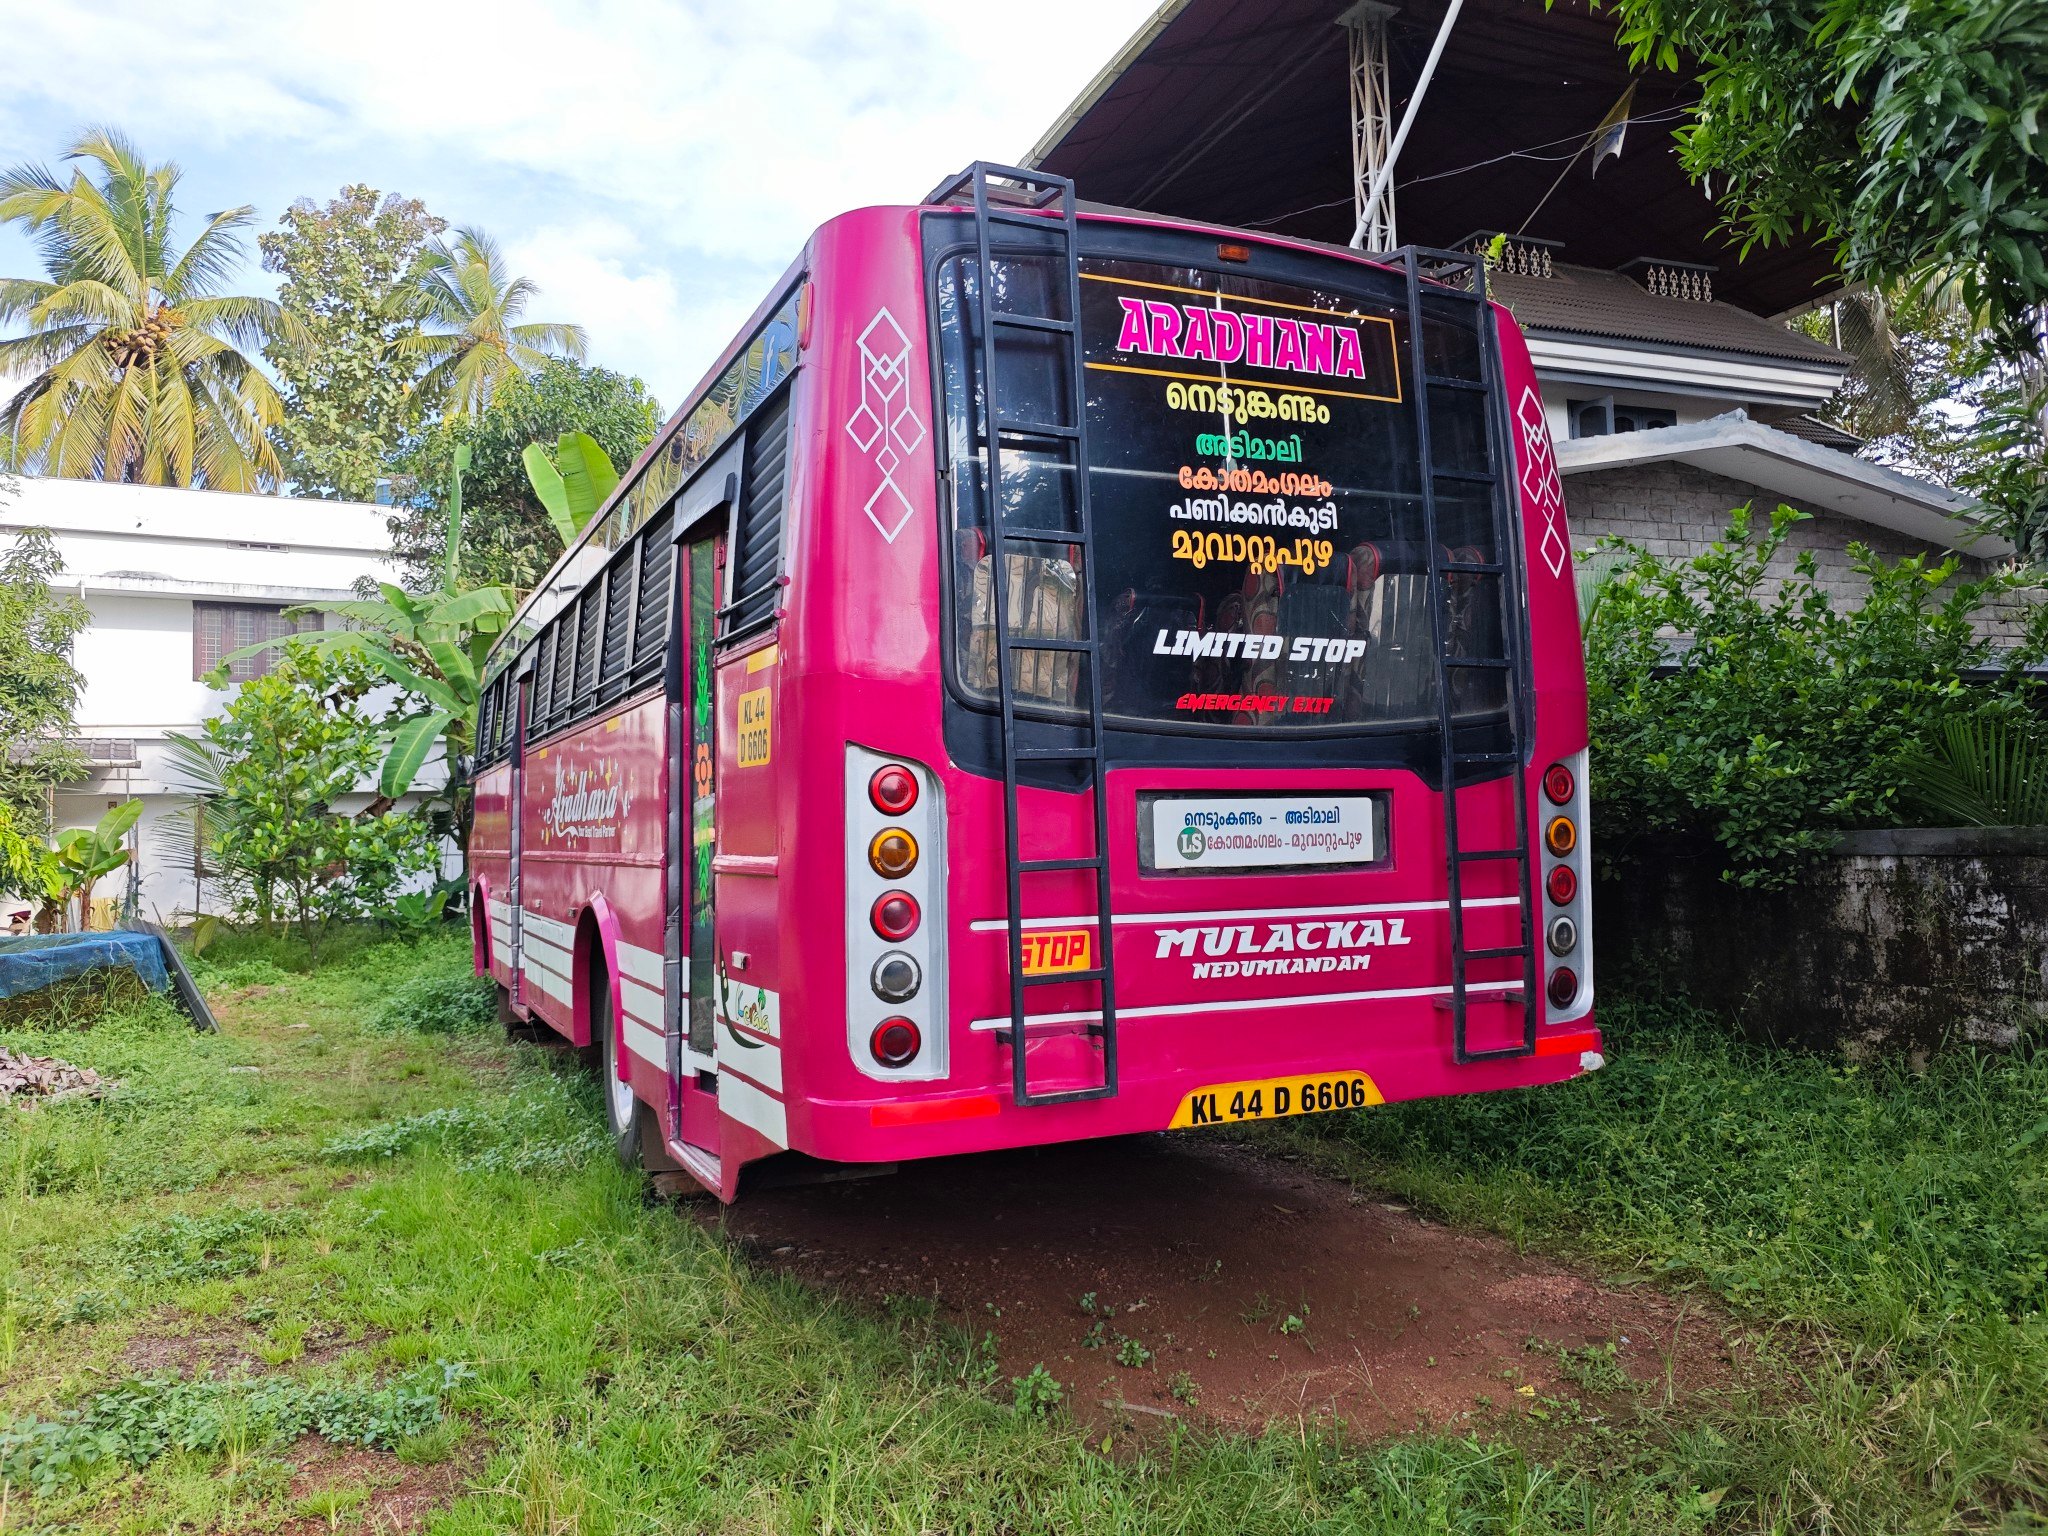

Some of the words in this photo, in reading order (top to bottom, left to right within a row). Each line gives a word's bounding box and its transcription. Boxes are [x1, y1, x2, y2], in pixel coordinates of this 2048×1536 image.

[1117, 296, 1366, 379] ARADHANA
[1166, 382, 1331, 424] നെടുങ്കണ്ടം
[1196, 429, 1303, 463] അടിമാലി
[1178, 465, 1333, 498] കോതമംഗലം
[1152, 629, 1284, 662] LIMITED
[1289, 637, 1366, 663] STOP
[744, 700, 753, 724] KL
[755, 696, 766, 721] 44
[1175, 693, 1289, 714] EMERGENCY
[1292, 697, 1334, 714] EXIT
[748, 728, 768, 761] 6606
[546, 766, 619, 836] Aradhana
[1184, 811, 1262, 831] നെടുംകണ്ടം
[1285, 806, 1340, 825] അടിമാലി
[1181, 833, 1202, 854] LS
[1021, 935, 1085, 968] STOP
[1155, 918, 1411, 959] MULACKAL
[1192, 954, 1371, 979] NEDUMKANDAM
[1192, 1094, 1222, 1124] KL
[1230, 1090, 1263, 1119] 44
[1274, 1087, 1290, 1115] D
[1301, 1078, 1365, 1112] 6606
